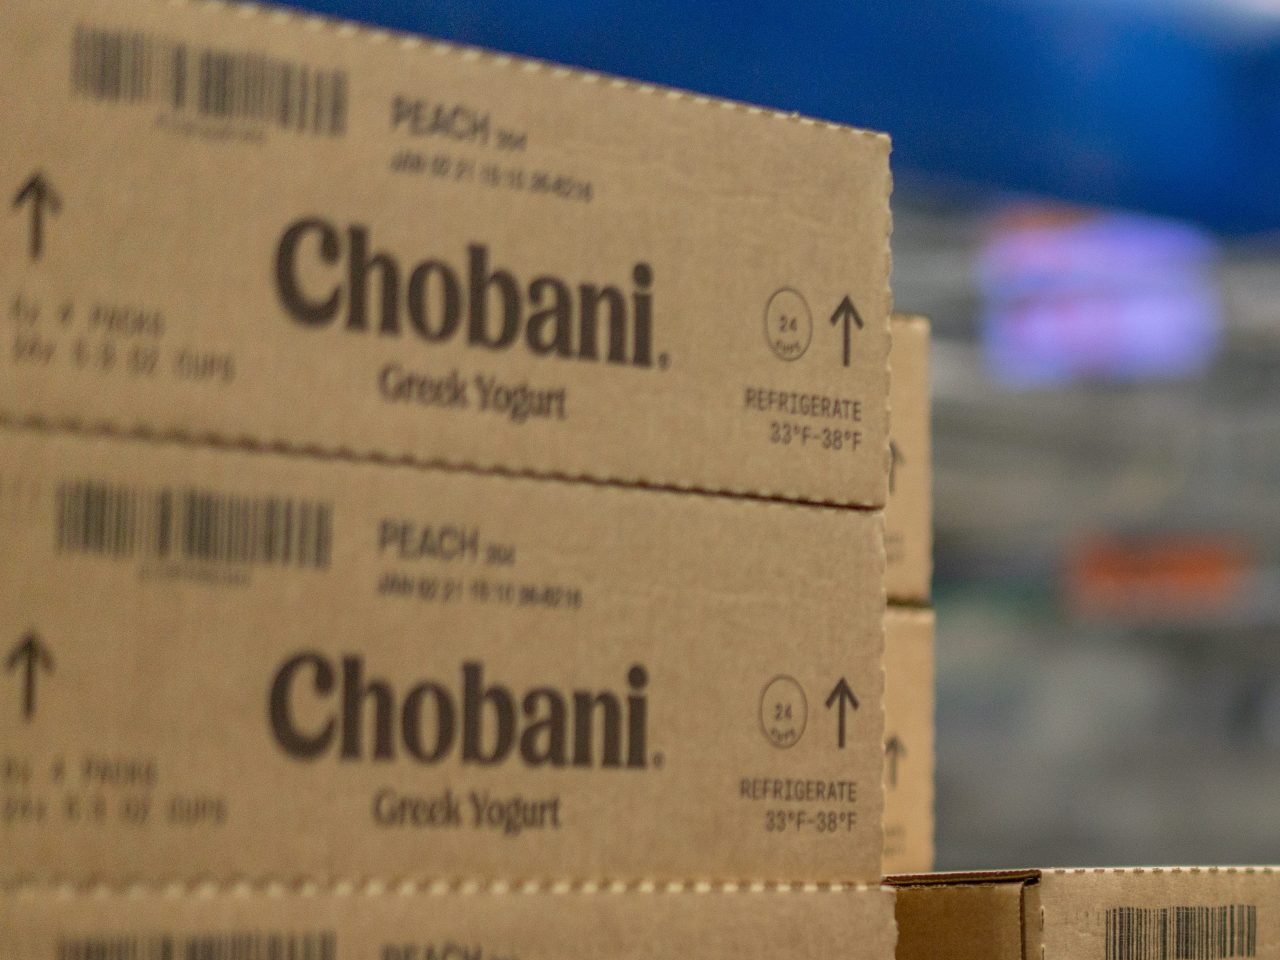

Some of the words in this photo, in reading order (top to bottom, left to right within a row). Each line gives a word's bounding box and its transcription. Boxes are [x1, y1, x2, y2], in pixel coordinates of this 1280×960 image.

[390, 93, 490, 145] PEACH
[778, 315, 798, 333] 24
[378, 363, 468, 408] Greek
[474, 375, 567, 424] Yogurt
[745, 387, 862, 421] REFRIGERATE
[378, 518, 480, 562] PEACH
[775, 703, 794, 720] 24
[741, 779, 857, 803] REFRIGERATE
[374, 789, 461, 828] Greek
[470, 791, 561, 836] Yogurt
